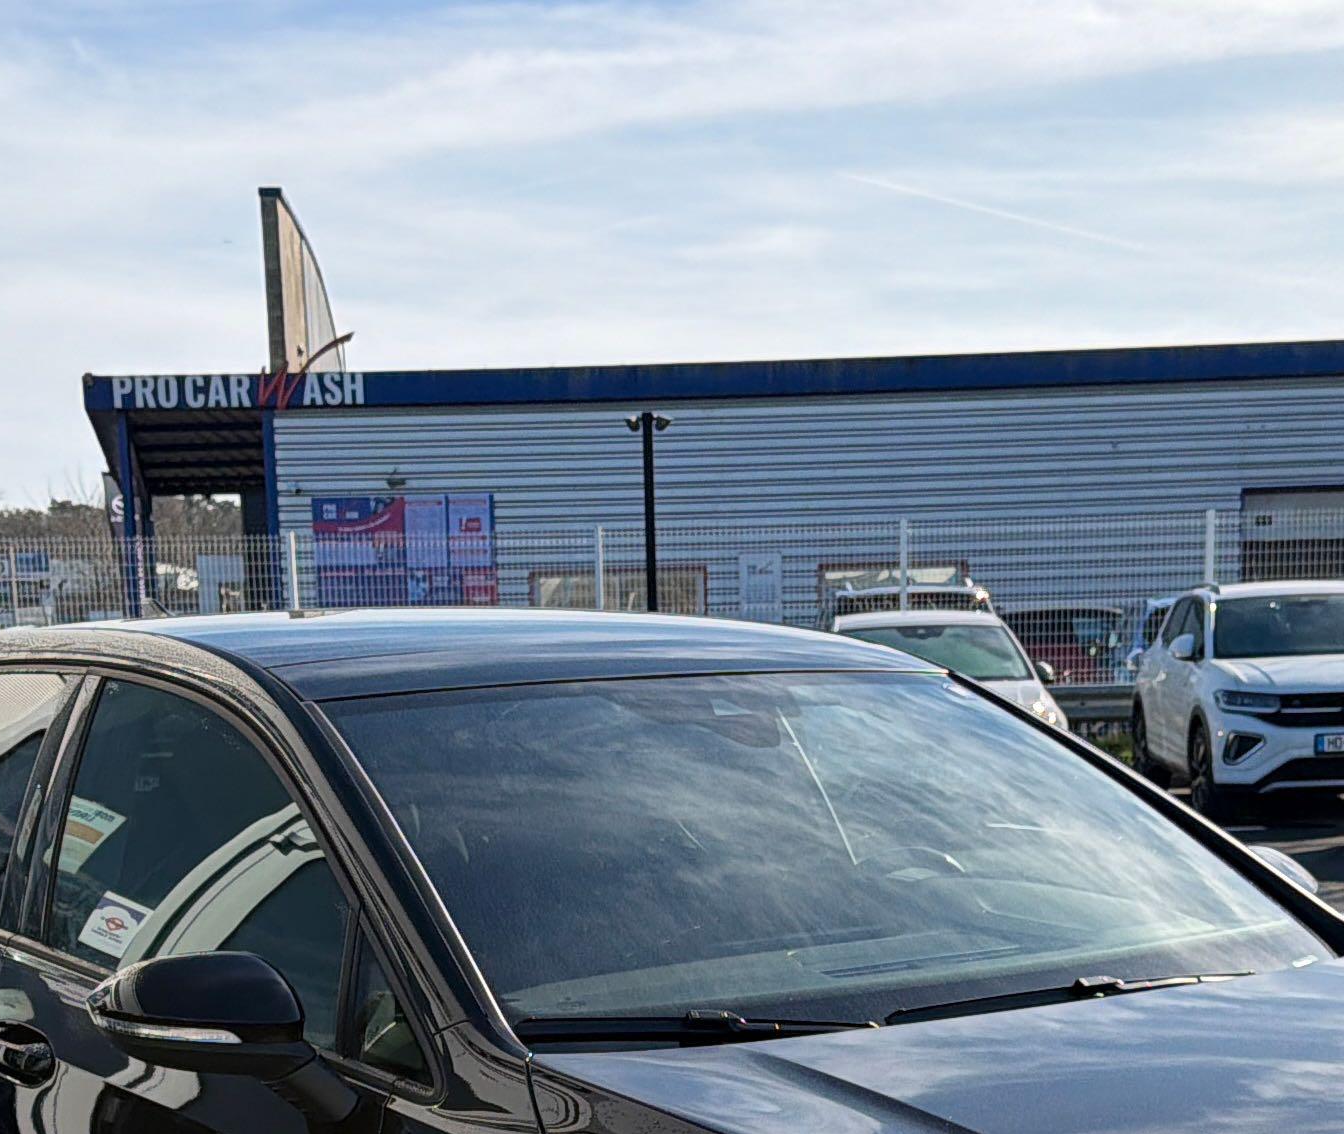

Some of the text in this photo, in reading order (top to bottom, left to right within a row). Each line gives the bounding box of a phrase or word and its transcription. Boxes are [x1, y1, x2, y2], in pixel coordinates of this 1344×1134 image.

[112, 331, 365, 410] PRO CAR WASH
